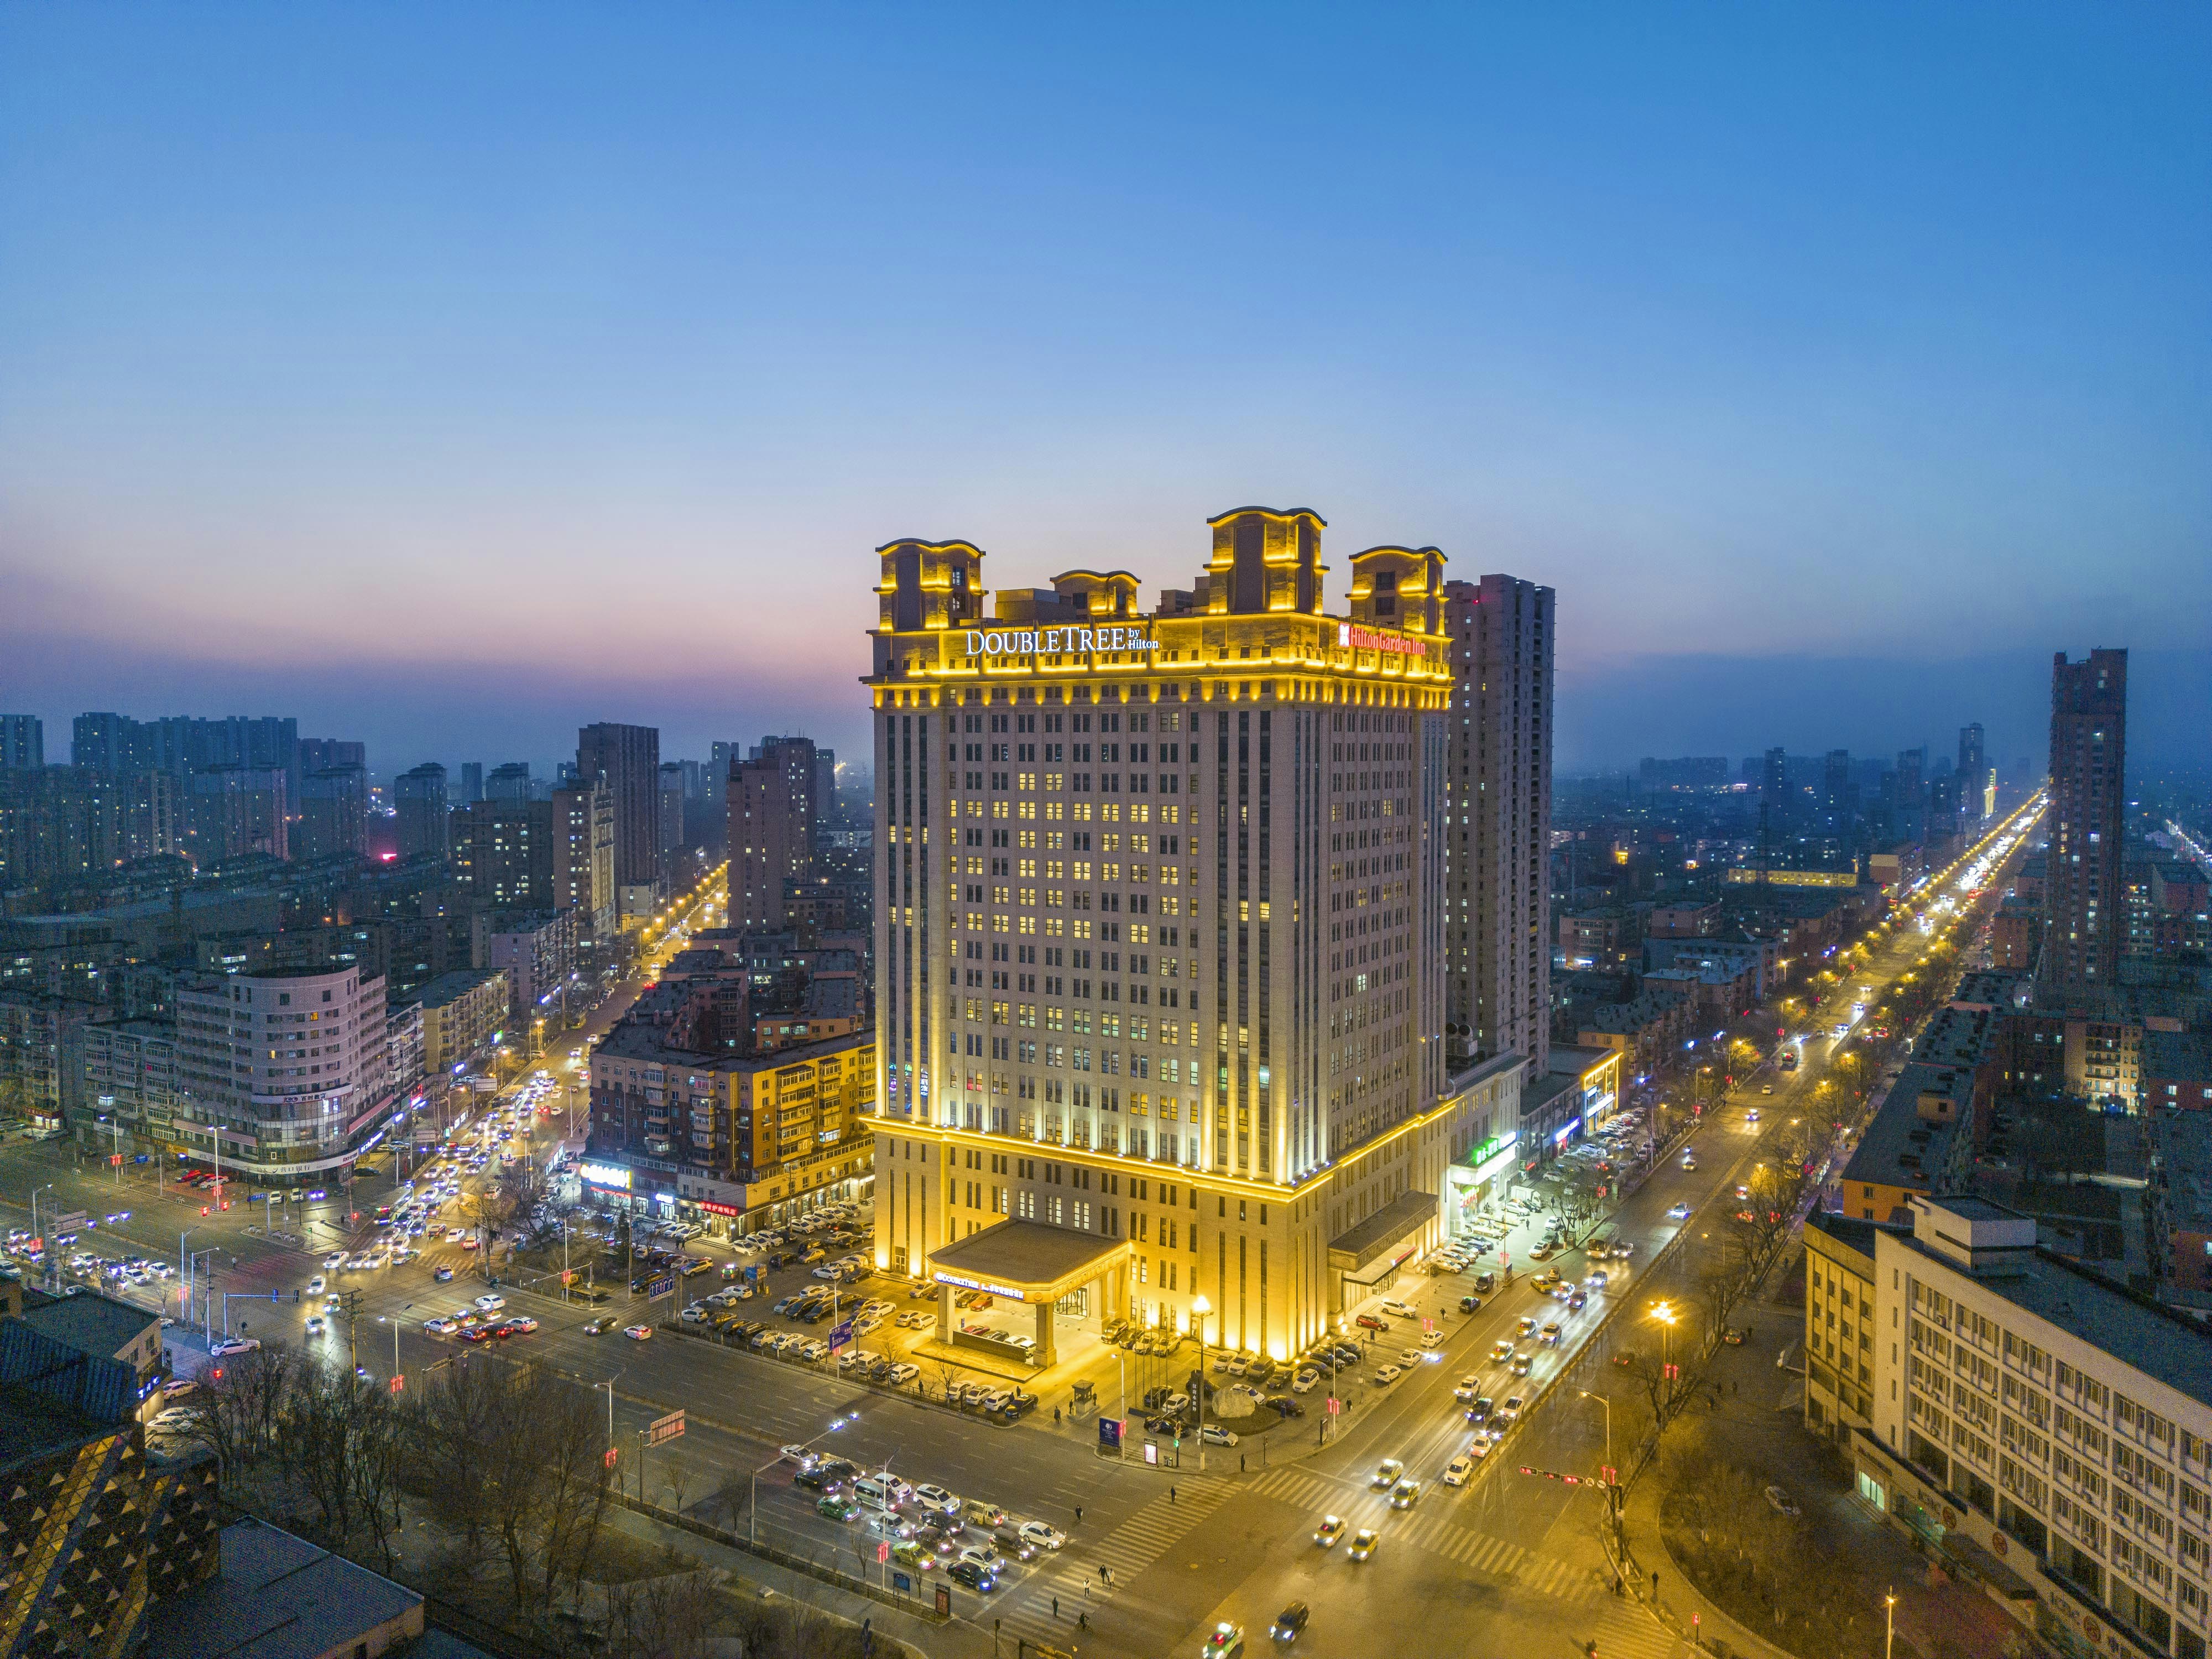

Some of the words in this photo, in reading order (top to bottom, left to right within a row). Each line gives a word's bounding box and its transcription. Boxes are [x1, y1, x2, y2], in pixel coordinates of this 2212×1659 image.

[966, 627, 1126, 655] DOUBLETREE
[1128, 627, 1140, 639] by
[1128, 639, 1159, 649] Hilton
[1350, 627, 1379, 649] Hilton
[1379, 632, 1411, 653] Garden
[1411, 637, 1426, 655] Inn
